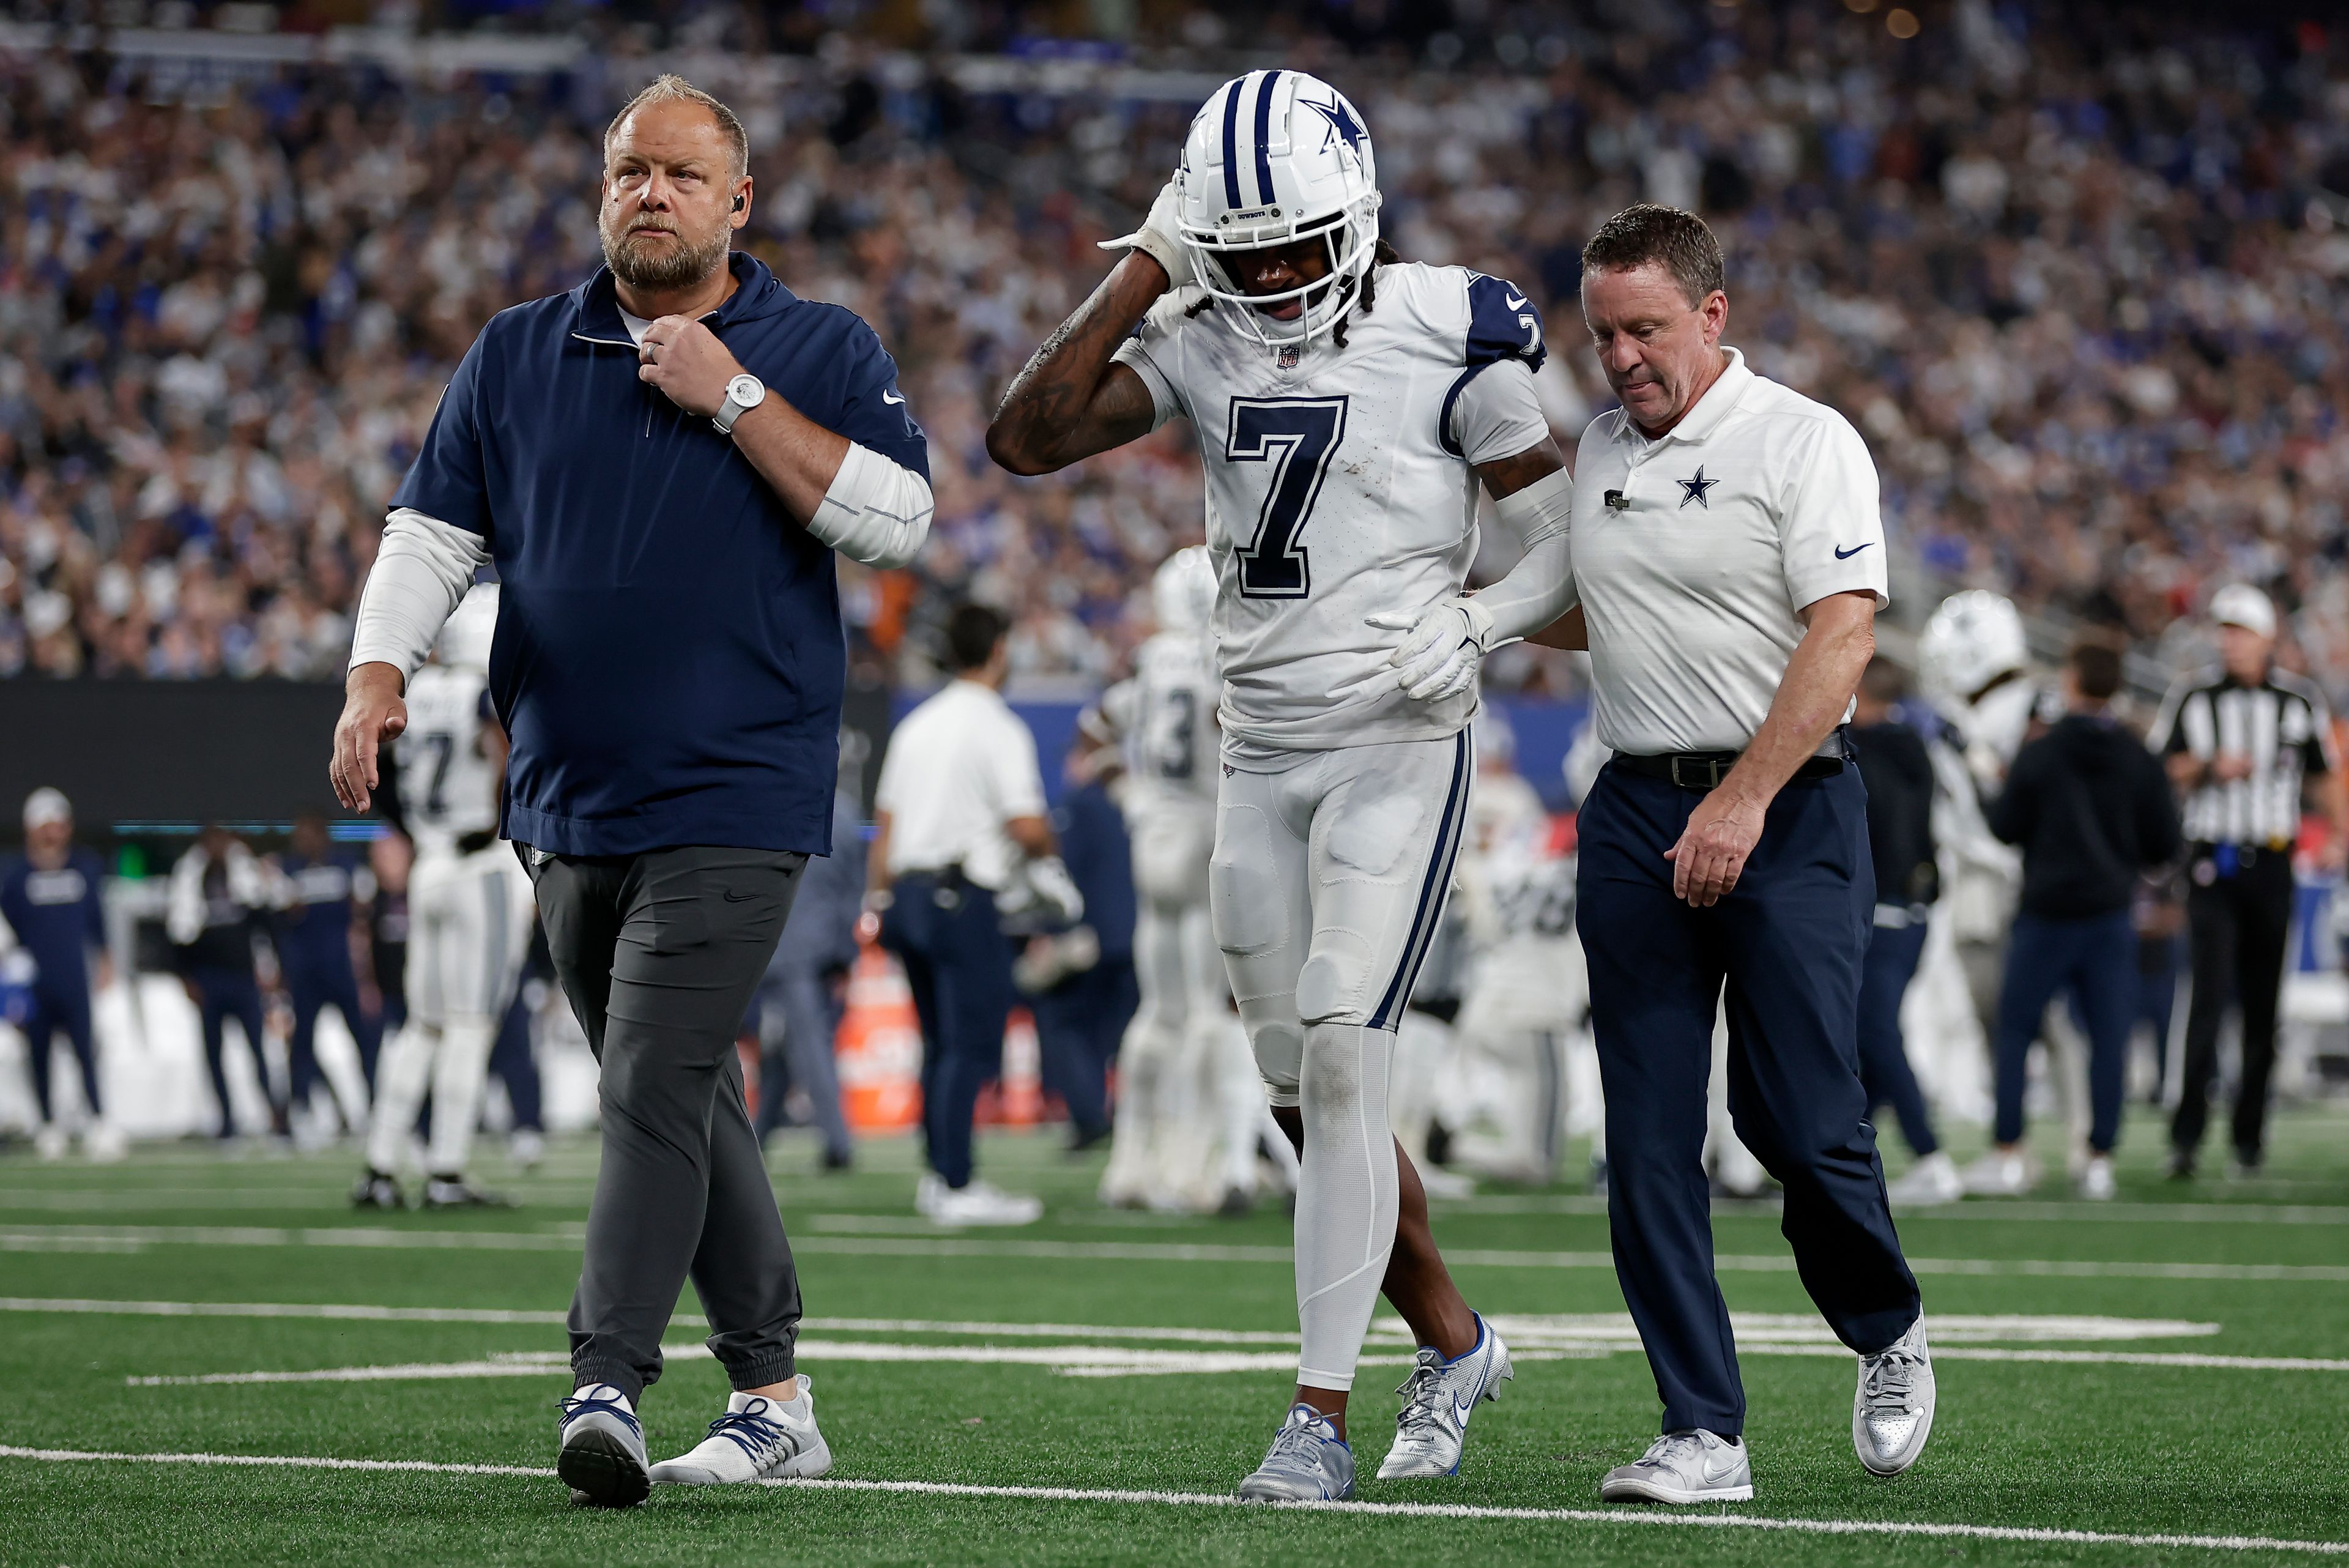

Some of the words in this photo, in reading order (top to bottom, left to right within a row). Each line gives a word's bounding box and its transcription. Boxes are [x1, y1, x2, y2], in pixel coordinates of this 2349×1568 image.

[1238, 210, 1266, 219] COWBOYS
[1518, 313, 1541, 355] 7
[1279, 355, 1297, 366] NFL
[1226, 395, 1349, 599] 7
[1161, 688, 1195, 778] 3
